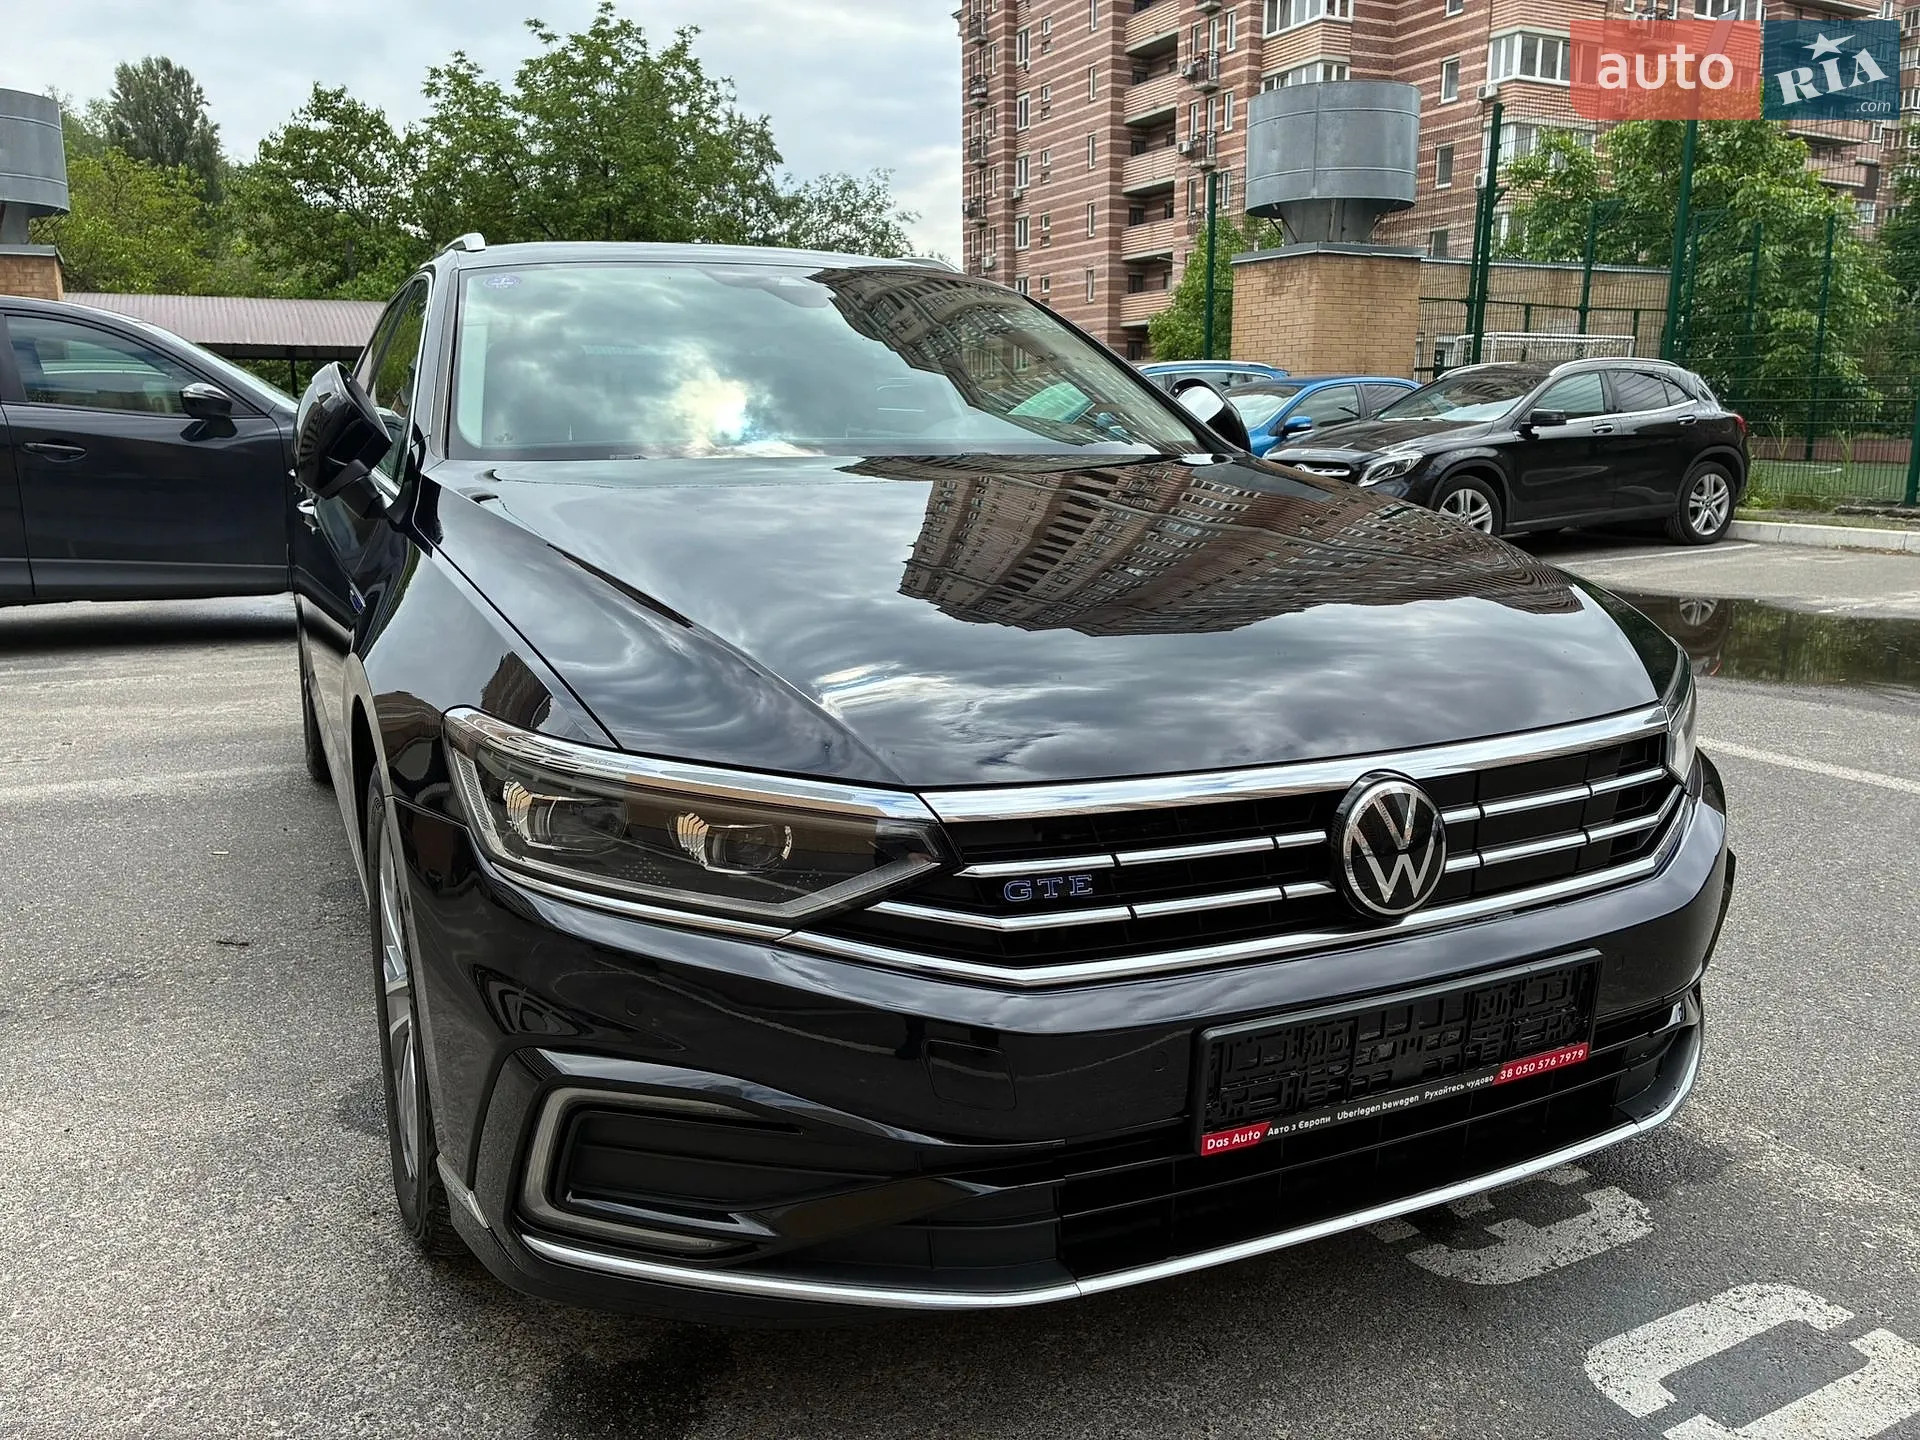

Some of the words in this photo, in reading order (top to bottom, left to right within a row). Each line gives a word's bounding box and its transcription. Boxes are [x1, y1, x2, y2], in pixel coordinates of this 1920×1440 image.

[1003, 873, 1094, 903] GTE
[1500, 1068, 1513, 1080] 38
[1515, 1062, 1535, 1076] 050
[1538, 1056, 1557, 1071] 576
[1558, 1049, 1585, 1066] 7979
[1424, 1083, 1464, 1100] Рухайтесь
[1466, 1074, 1494, 1089] чудово
[1382, 1095, 1419, 1110] bewegen
[1267, 1125, 1290, 1137] Авто
[1298, 1116, 1332, 1130] Європи
[1207, 1136, 1229, 1150] Das
[1232, 1129, 1261, 1145] Auto
